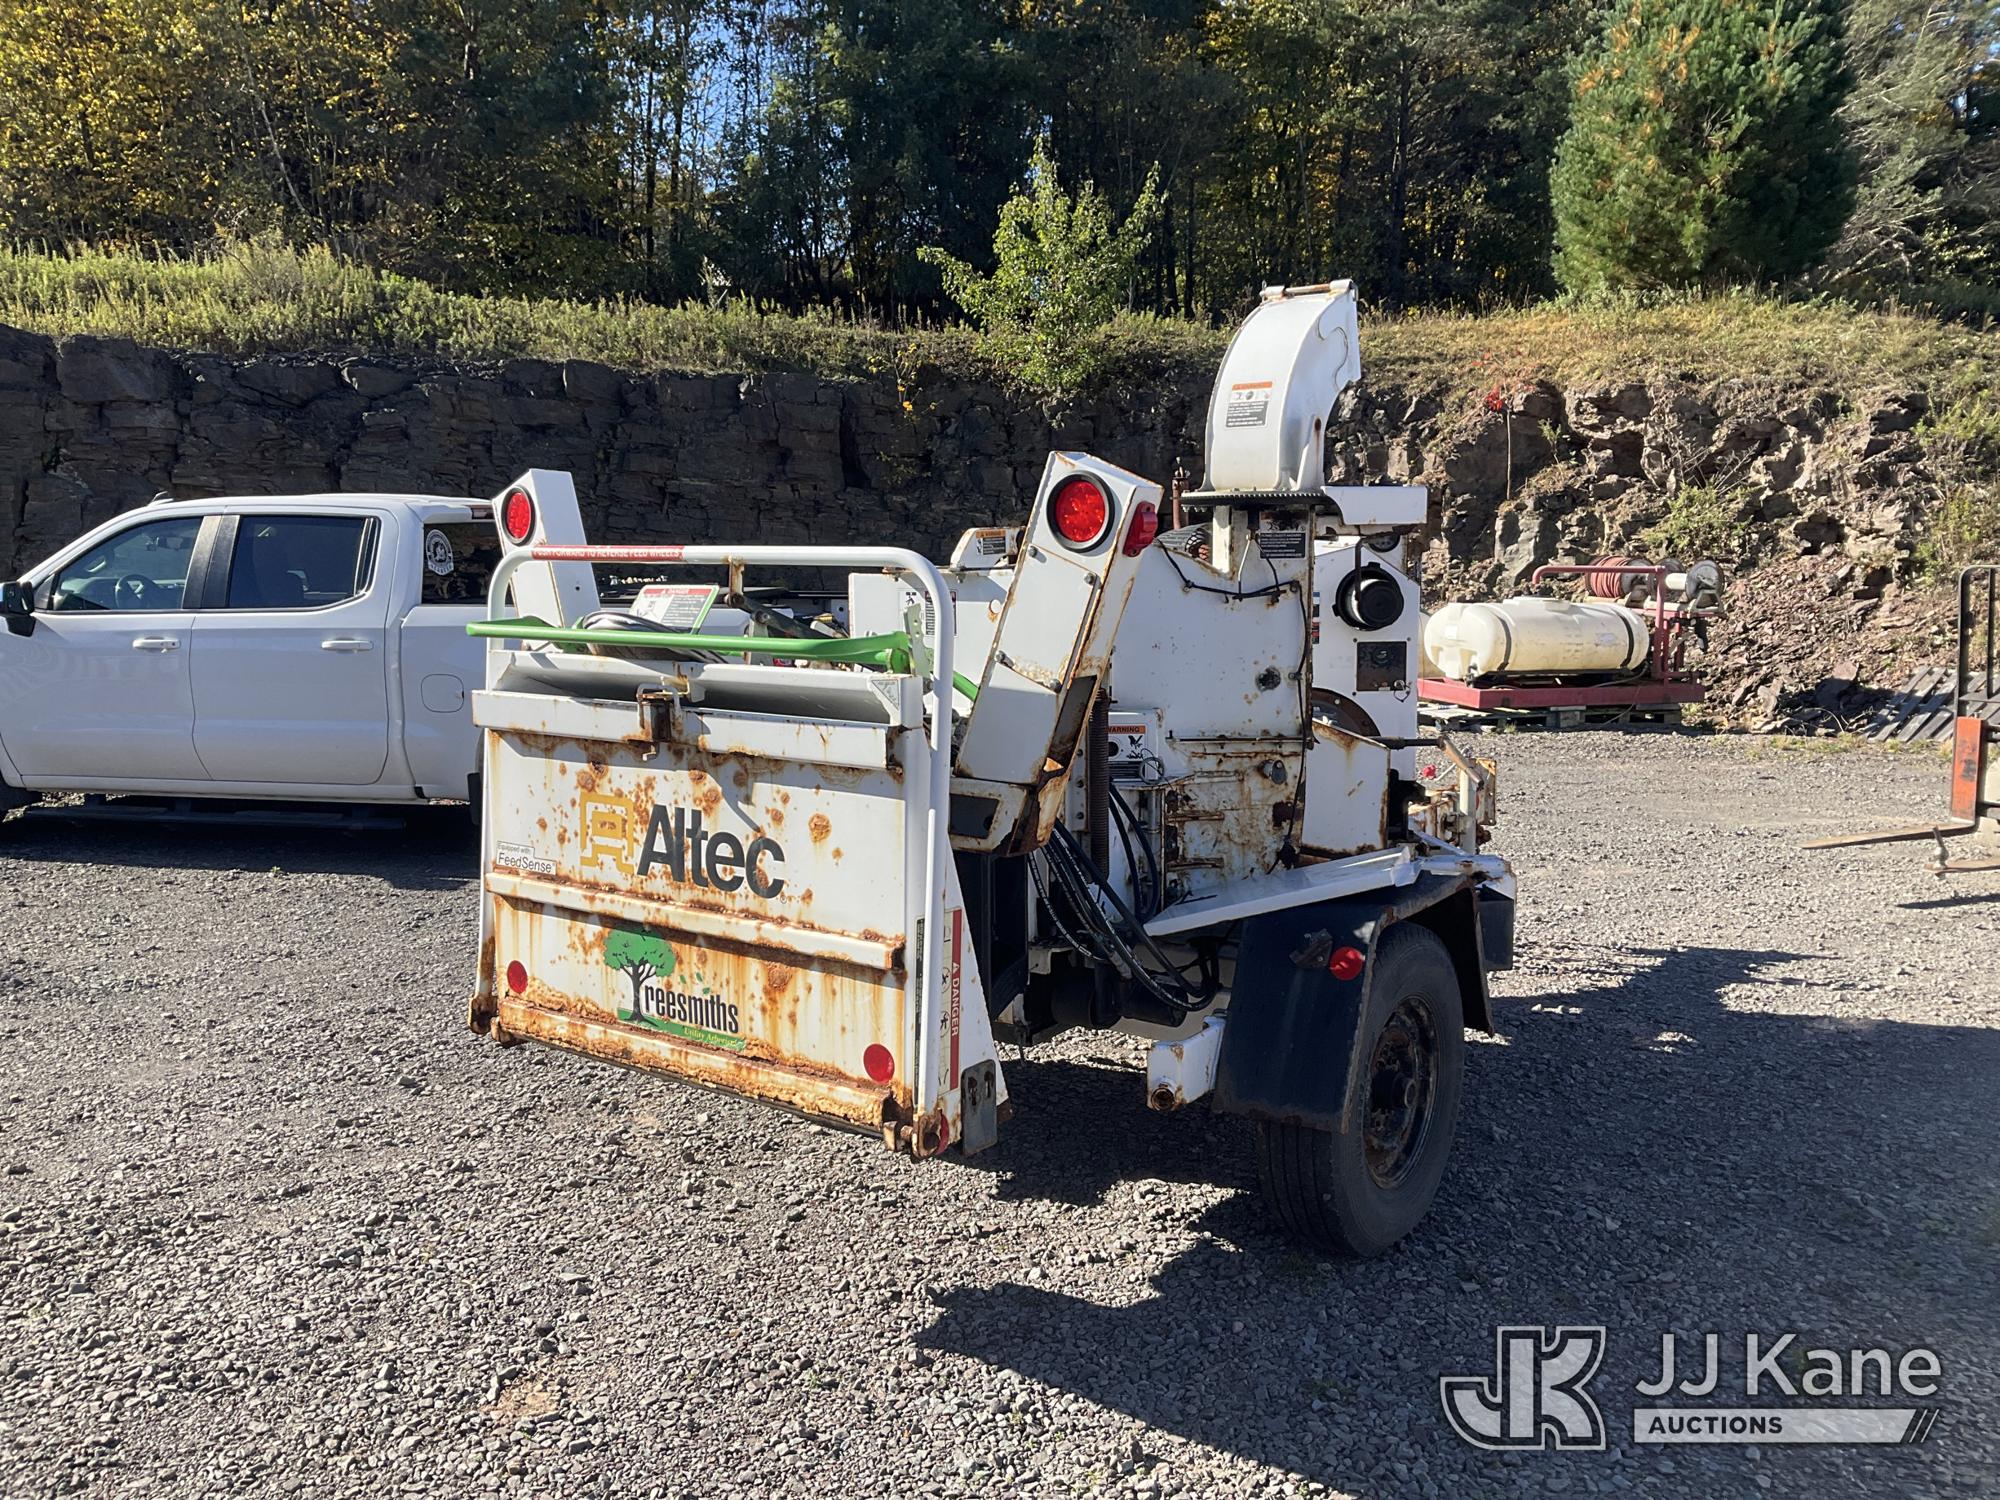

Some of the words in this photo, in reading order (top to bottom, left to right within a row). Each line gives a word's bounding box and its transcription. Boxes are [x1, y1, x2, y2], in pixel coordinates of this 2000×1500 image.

[498, 852, 552, 874] FeedSense
[637, 804, 786, 899] Altec
[951, 978, 960, 1037] DANGER
